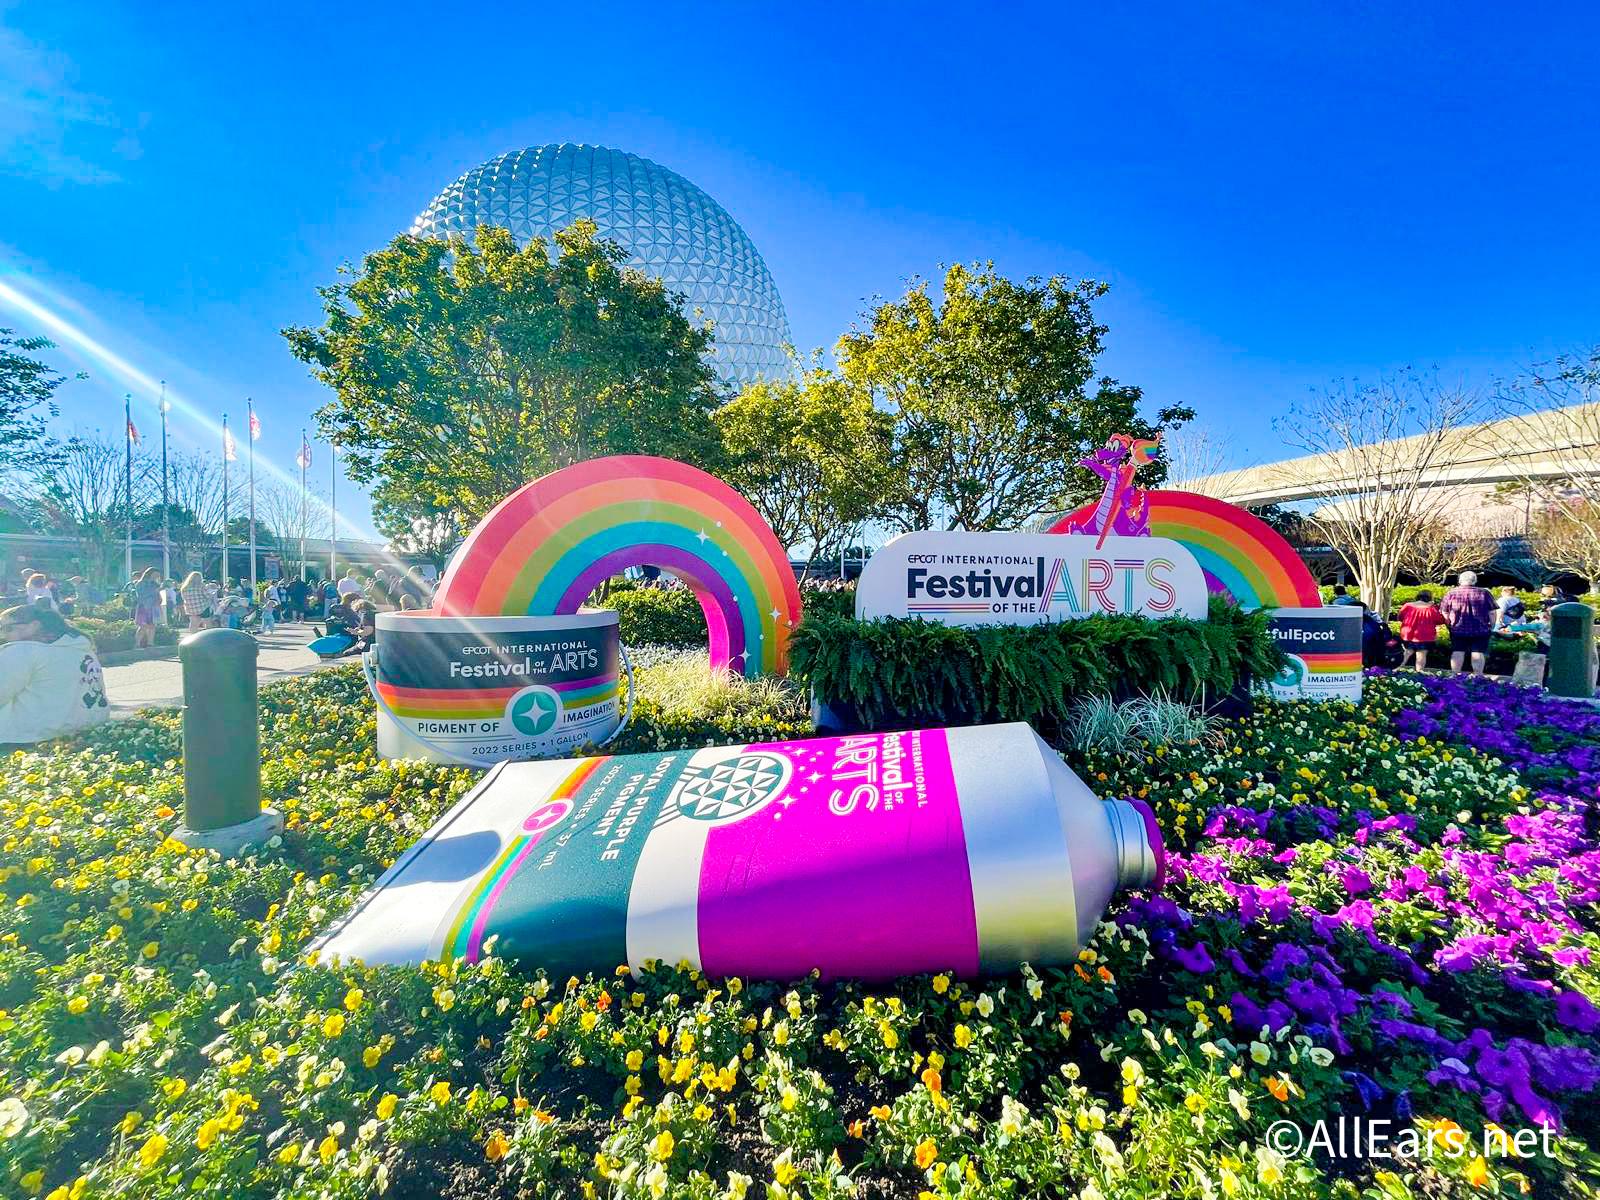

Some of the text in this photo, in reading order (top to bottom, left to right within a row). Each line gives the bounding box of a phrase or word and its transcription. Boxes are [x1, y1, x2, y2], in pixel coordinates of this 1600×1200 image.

[908, 554, 1035, 565] EPCOT INTERNATIONAL
[907, 556, 1044, 598] Festival
[1039, 557, 1176, 613] ARTS
[992, 603, 1035, 613] OF THE
[462, 640, 588, 655] EPCOT INTERNATIONAL
[450, 657, 531, 678] Festival
[549, 648, 598, 673] ARTS
[417, 722, 477, 734] PIGMENT
[480, 722, 500, 733] OF
[472, 746, 498, 755] 2022
[502, 741, 537, 753] SERIES
[556, 731, 589, 745] GALLON
[601, 764, 624, 785] 2022
[828, 737, 880, 816] ARTS
[574, 786, 605, 820] SERIES
[592, 774, 645, 837] PIGMENT
[601, 755, 677, 861] ROYAL PURPLE
[884, 793, 894, 811] THE
[895, 791, 904, 804] OF
[555, 832, 572, 847] 37
